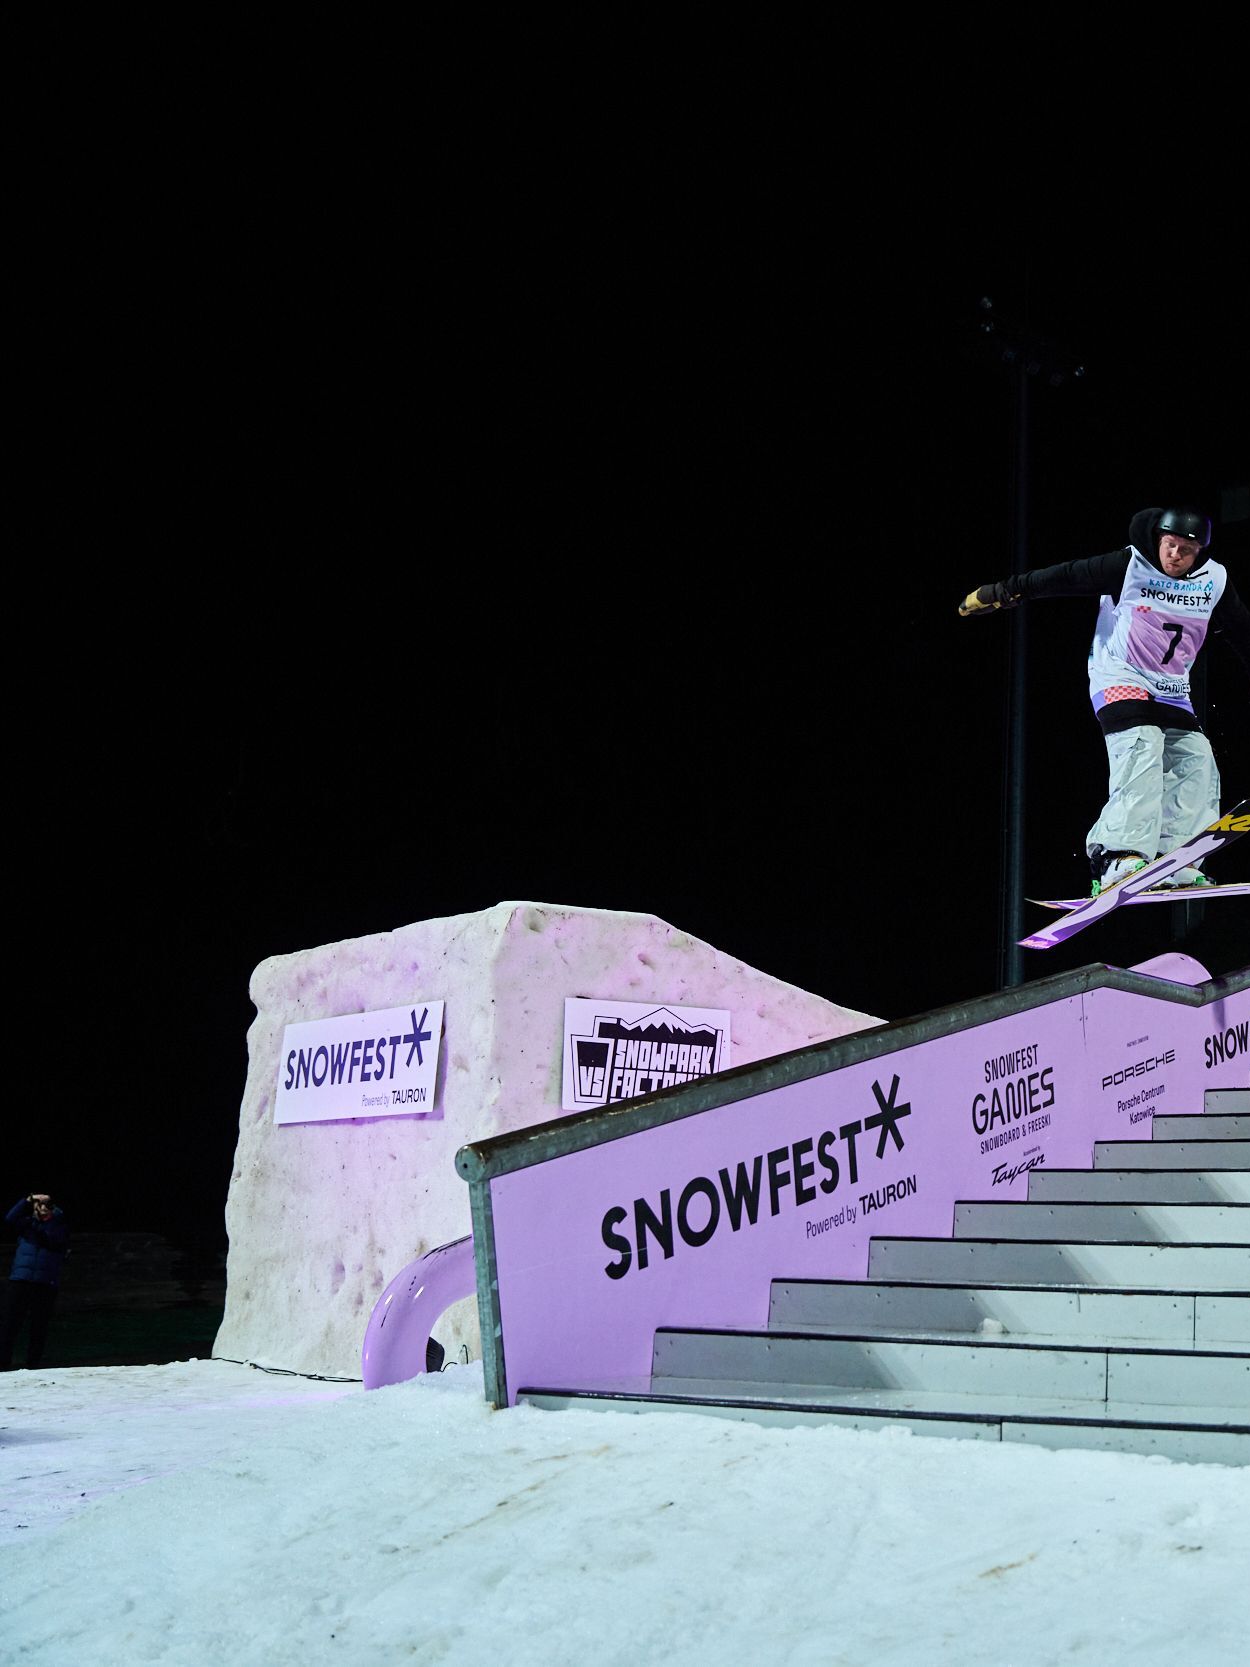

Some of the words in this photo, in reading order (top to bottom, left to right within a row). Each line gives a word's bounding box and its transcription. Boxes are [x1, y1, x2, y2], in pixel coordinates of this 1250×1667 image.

[1140, 587, 1202, 607] SNOWFEST
[1161, 622, 1184, 665] 7
[284, 1035, 401, 1090] SNOWFEST
[614, 1038, 715, 1075] SNOWPARK
[984, 1043, 1039, 1084] SNOWFEST
[1101, 1048, 1176, 1091] PORSCHE
[361, 1094, 384, 1107] Powered
[391, 1087, 427, 1105] TAURON
[579, 1065, 605, 1097] VS
[972, 1067, 1055, 1135] GAMES
[1117, 1093, 1141, 1113] Porsche
[1140, 1084, 1166, 1103] Centrum
[980, 1126, 1021, 1155] SNOWBOARD
[1022, 1124, 1027, 1137] &
[1027, 1113, 1051, 1135] FREESKI
[1129, 1105, 1156, 1126] Katowice
[991, 1153, 1046, 1187] Taycan
[601, 1120, 862, 1280] SNOWFEST
[806, 1207, 845, 1239] Powered
[846, 1205, 857, 1226] by
[859, 1175, 918, 1217] TAURON
